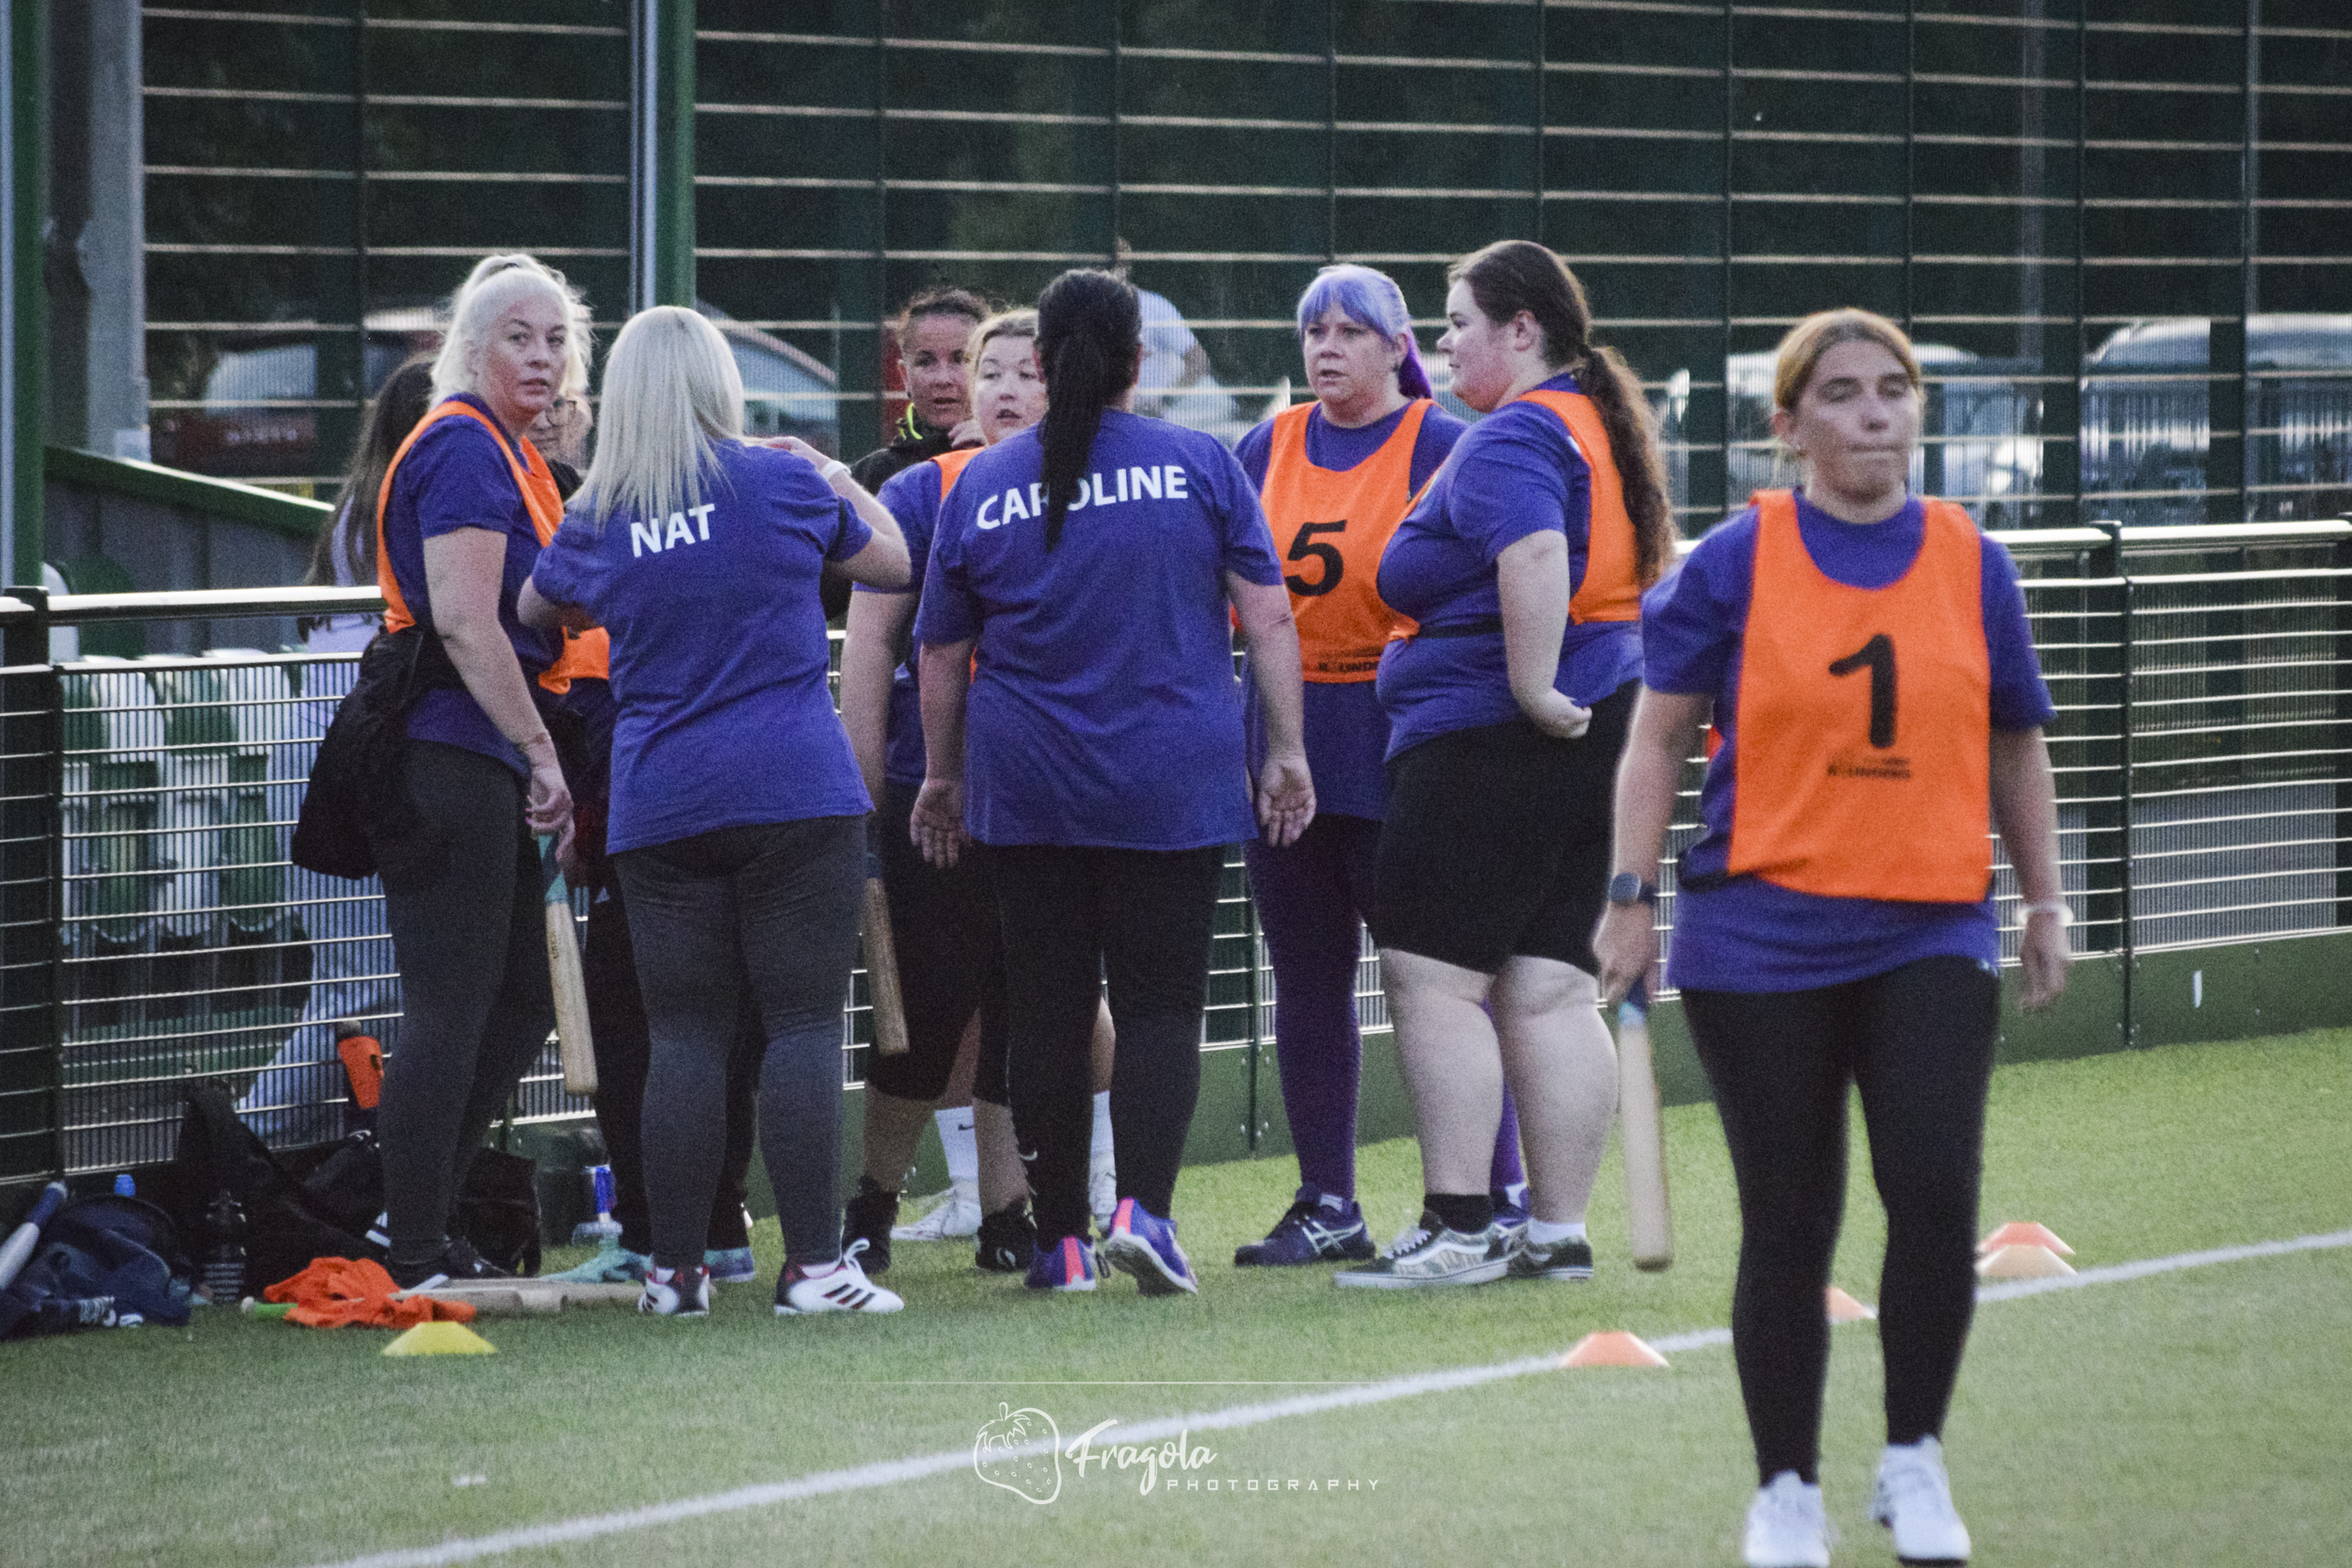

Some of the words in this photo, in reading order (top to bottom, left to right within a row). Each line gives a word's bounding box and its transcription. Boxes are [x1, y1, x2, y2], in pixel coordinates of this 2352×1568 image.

[630, 503, 715, 558] NAT
[1285, 519, 1347, 596] 5
[1828, 633, 1899, 749] 1
